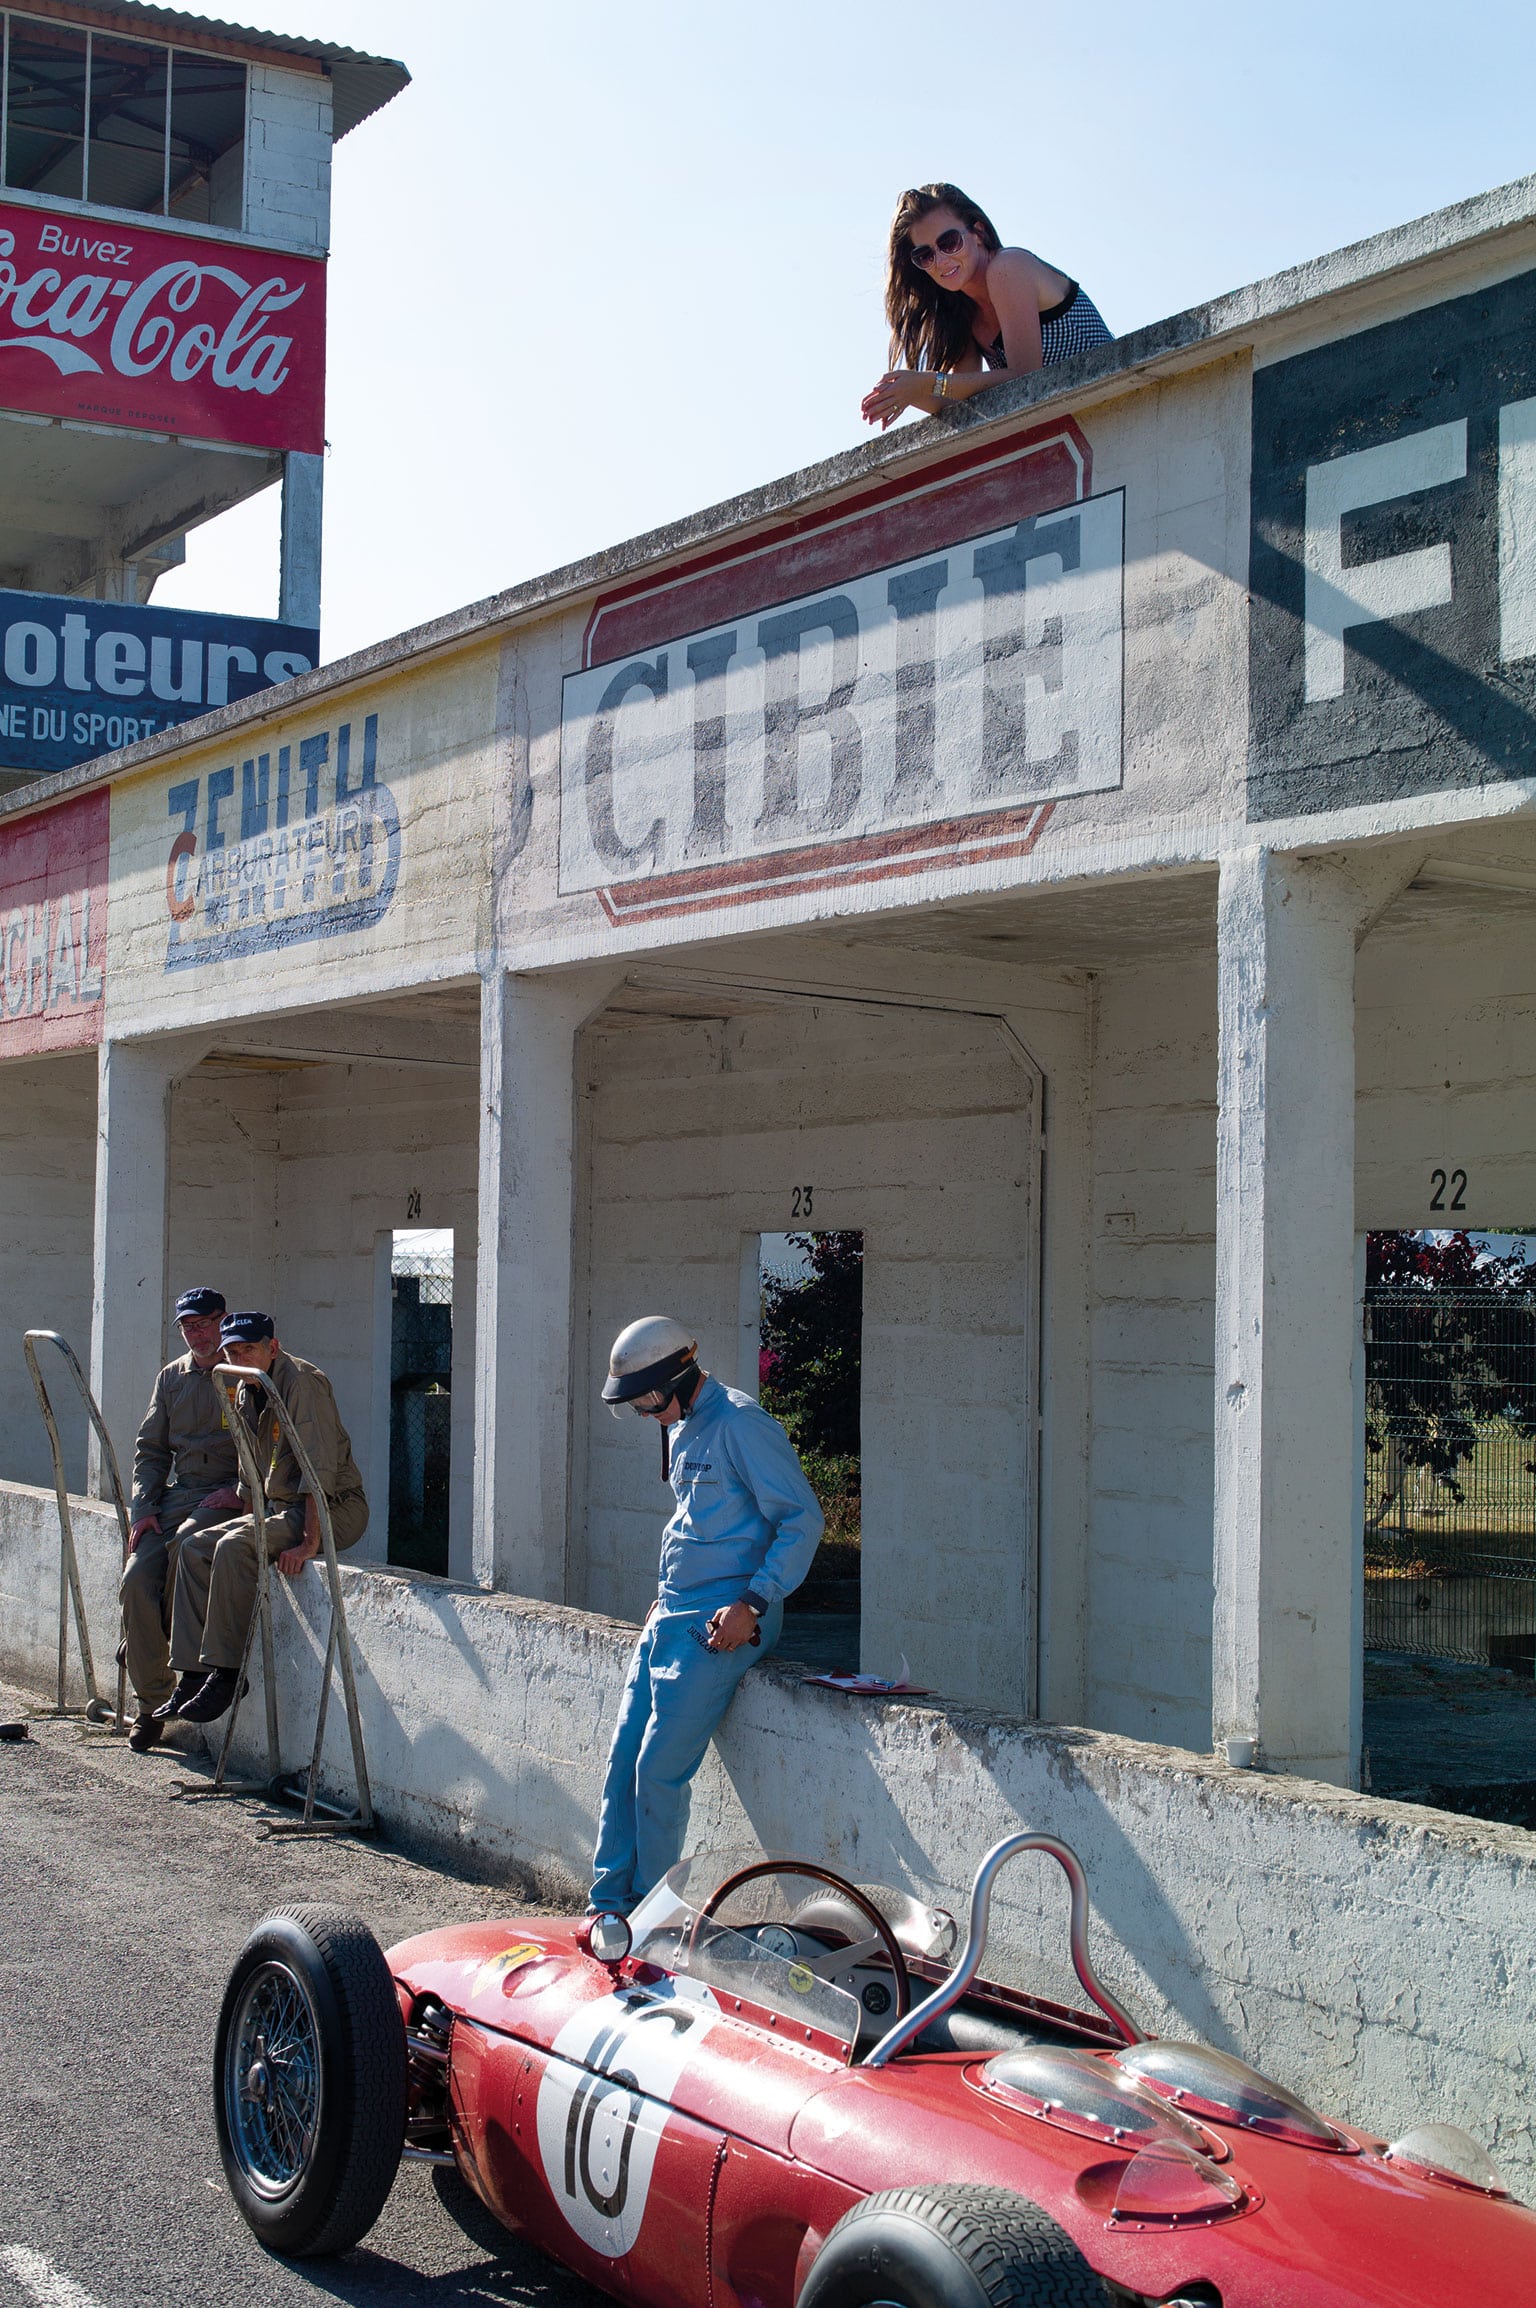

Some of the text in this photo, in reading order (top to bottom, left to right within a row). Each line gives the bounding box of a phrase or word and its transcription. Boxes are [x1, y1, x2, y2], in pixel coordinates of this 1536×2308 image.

[38, 224, 133, 265] Buvez
[78, 403, 122, 416] MARQUE
[1305, 397, 1536, 704] F
[33, 707, 66, 742] DU
[73, 712, 155, 748] SPORT
[0, 888, 102, 1017] CHAL
[407, 1193, 421, 1220] 24
[791, 1186, 814, 1219] 23
[1430, 1169, 1467, 1211] 22
